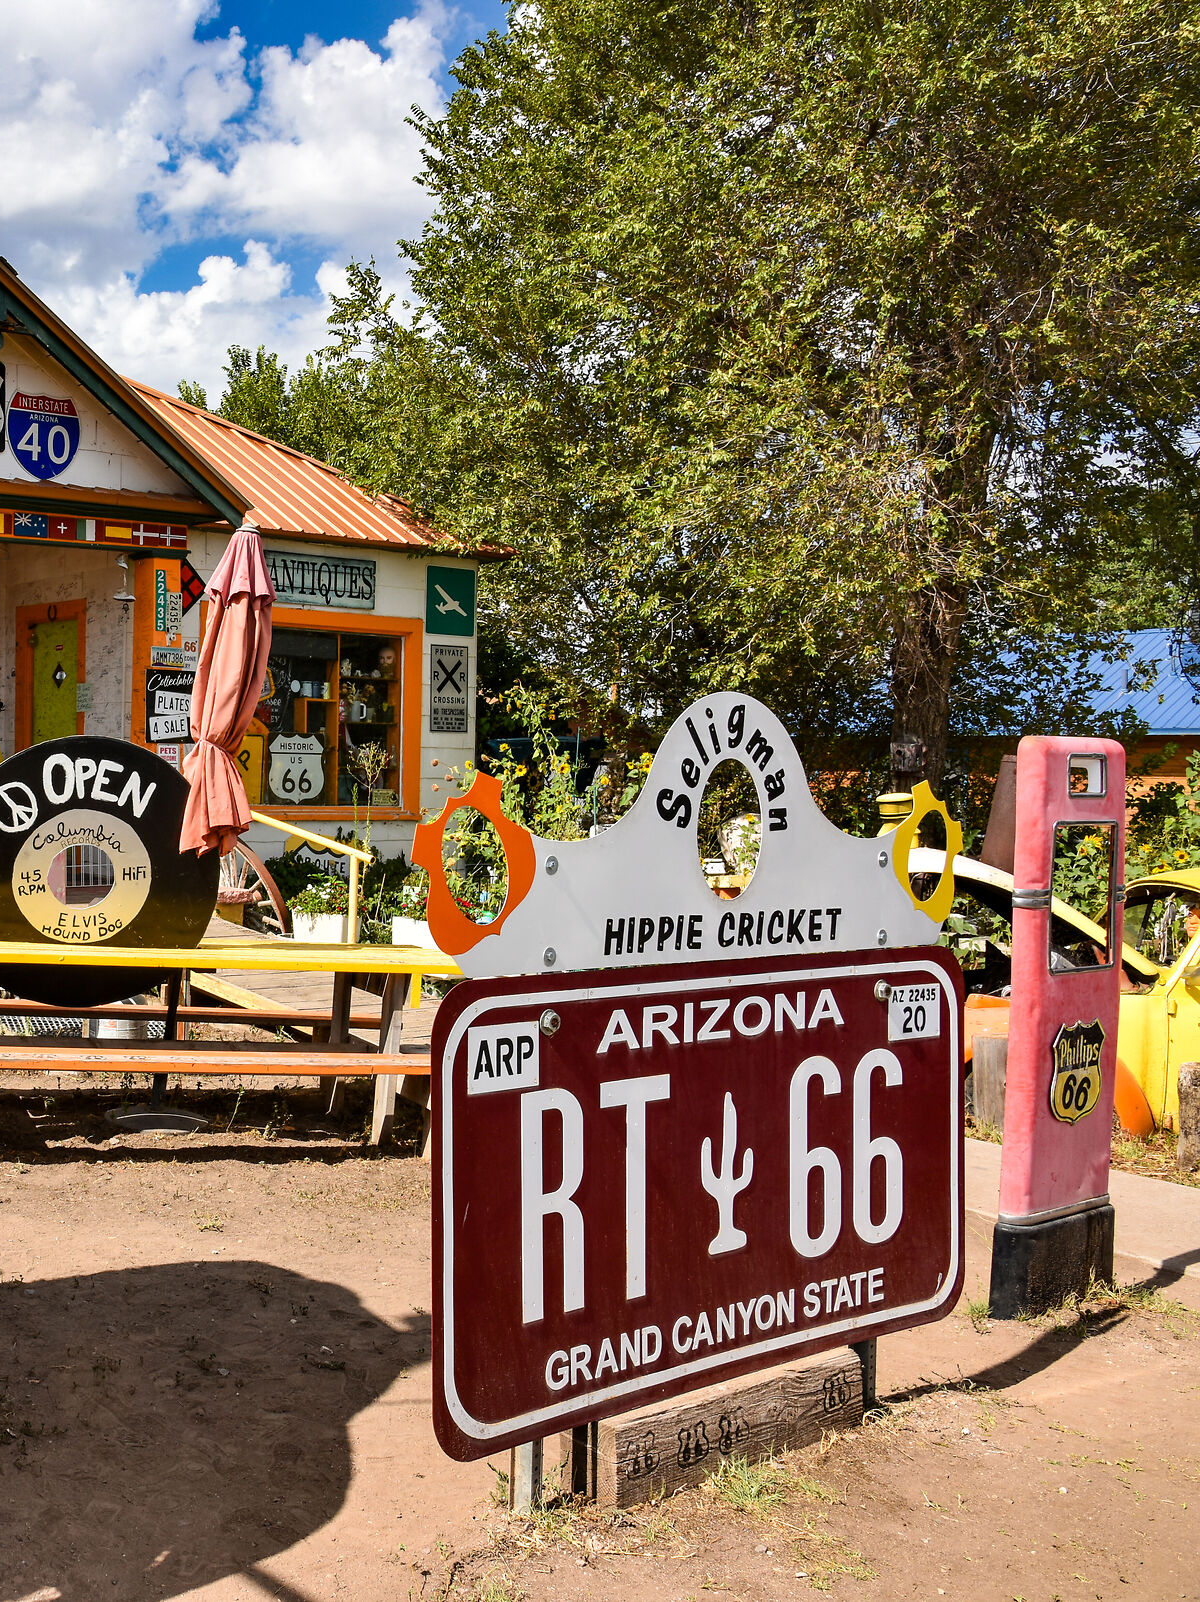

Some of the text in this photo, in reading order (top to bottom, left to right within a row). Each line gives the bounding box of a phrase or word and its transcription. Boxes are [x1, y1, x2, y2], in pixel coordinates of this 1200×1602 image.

[18, 396, 70, 414] INTERSTATE
[29, 413, 59, 424] ARIZONA
[17, 422, 70, 465] 40
[270, 557, 373, 605] ANTIQUES
[435, 648, 464, 657] PRIVATE
[433, 671, 466, 682] R R
[157, 696, 190, 712] PLATES
[433, 696, 465, 704] CROSSING
[153, 718, 186, 735] 4 SALE
[160, 747, 176, 755] PETS
[280, 743, 314, 751] HISTORIC
[657, 703, 790, 833] Seligman
[42, 753, 157, 818] OPEN
[282, 768, 312, 794] 66
[32, 822, 126, 854] Columbia
[60, 836, 101, 849] RECORDS
[20, 869, 42, 883] 45
[122, 866, 147, 881] HiFi
[18, 884, 46, 896] RPM
[41, 919, 123, 941] HOUND DOG
[58, 912, 107, 928] ELVIS
[604, 907, 842, 956] HIPPIE CRICKET
[892, 988, 936, 1003] AZ 22435
[597, 988, 845, 1054] ARIZONA
[902, 1005, 926, 1033] 20
[473, 1035, 535, 1081] ARP
[1058, 1034, 1099, 1070] Phillips
[1062, 1073, 1091, 1111] 66
[521, 1048, 903, 1325] RT 66
[545, 1267, 885, 1392] GRAND CANYON STATE
